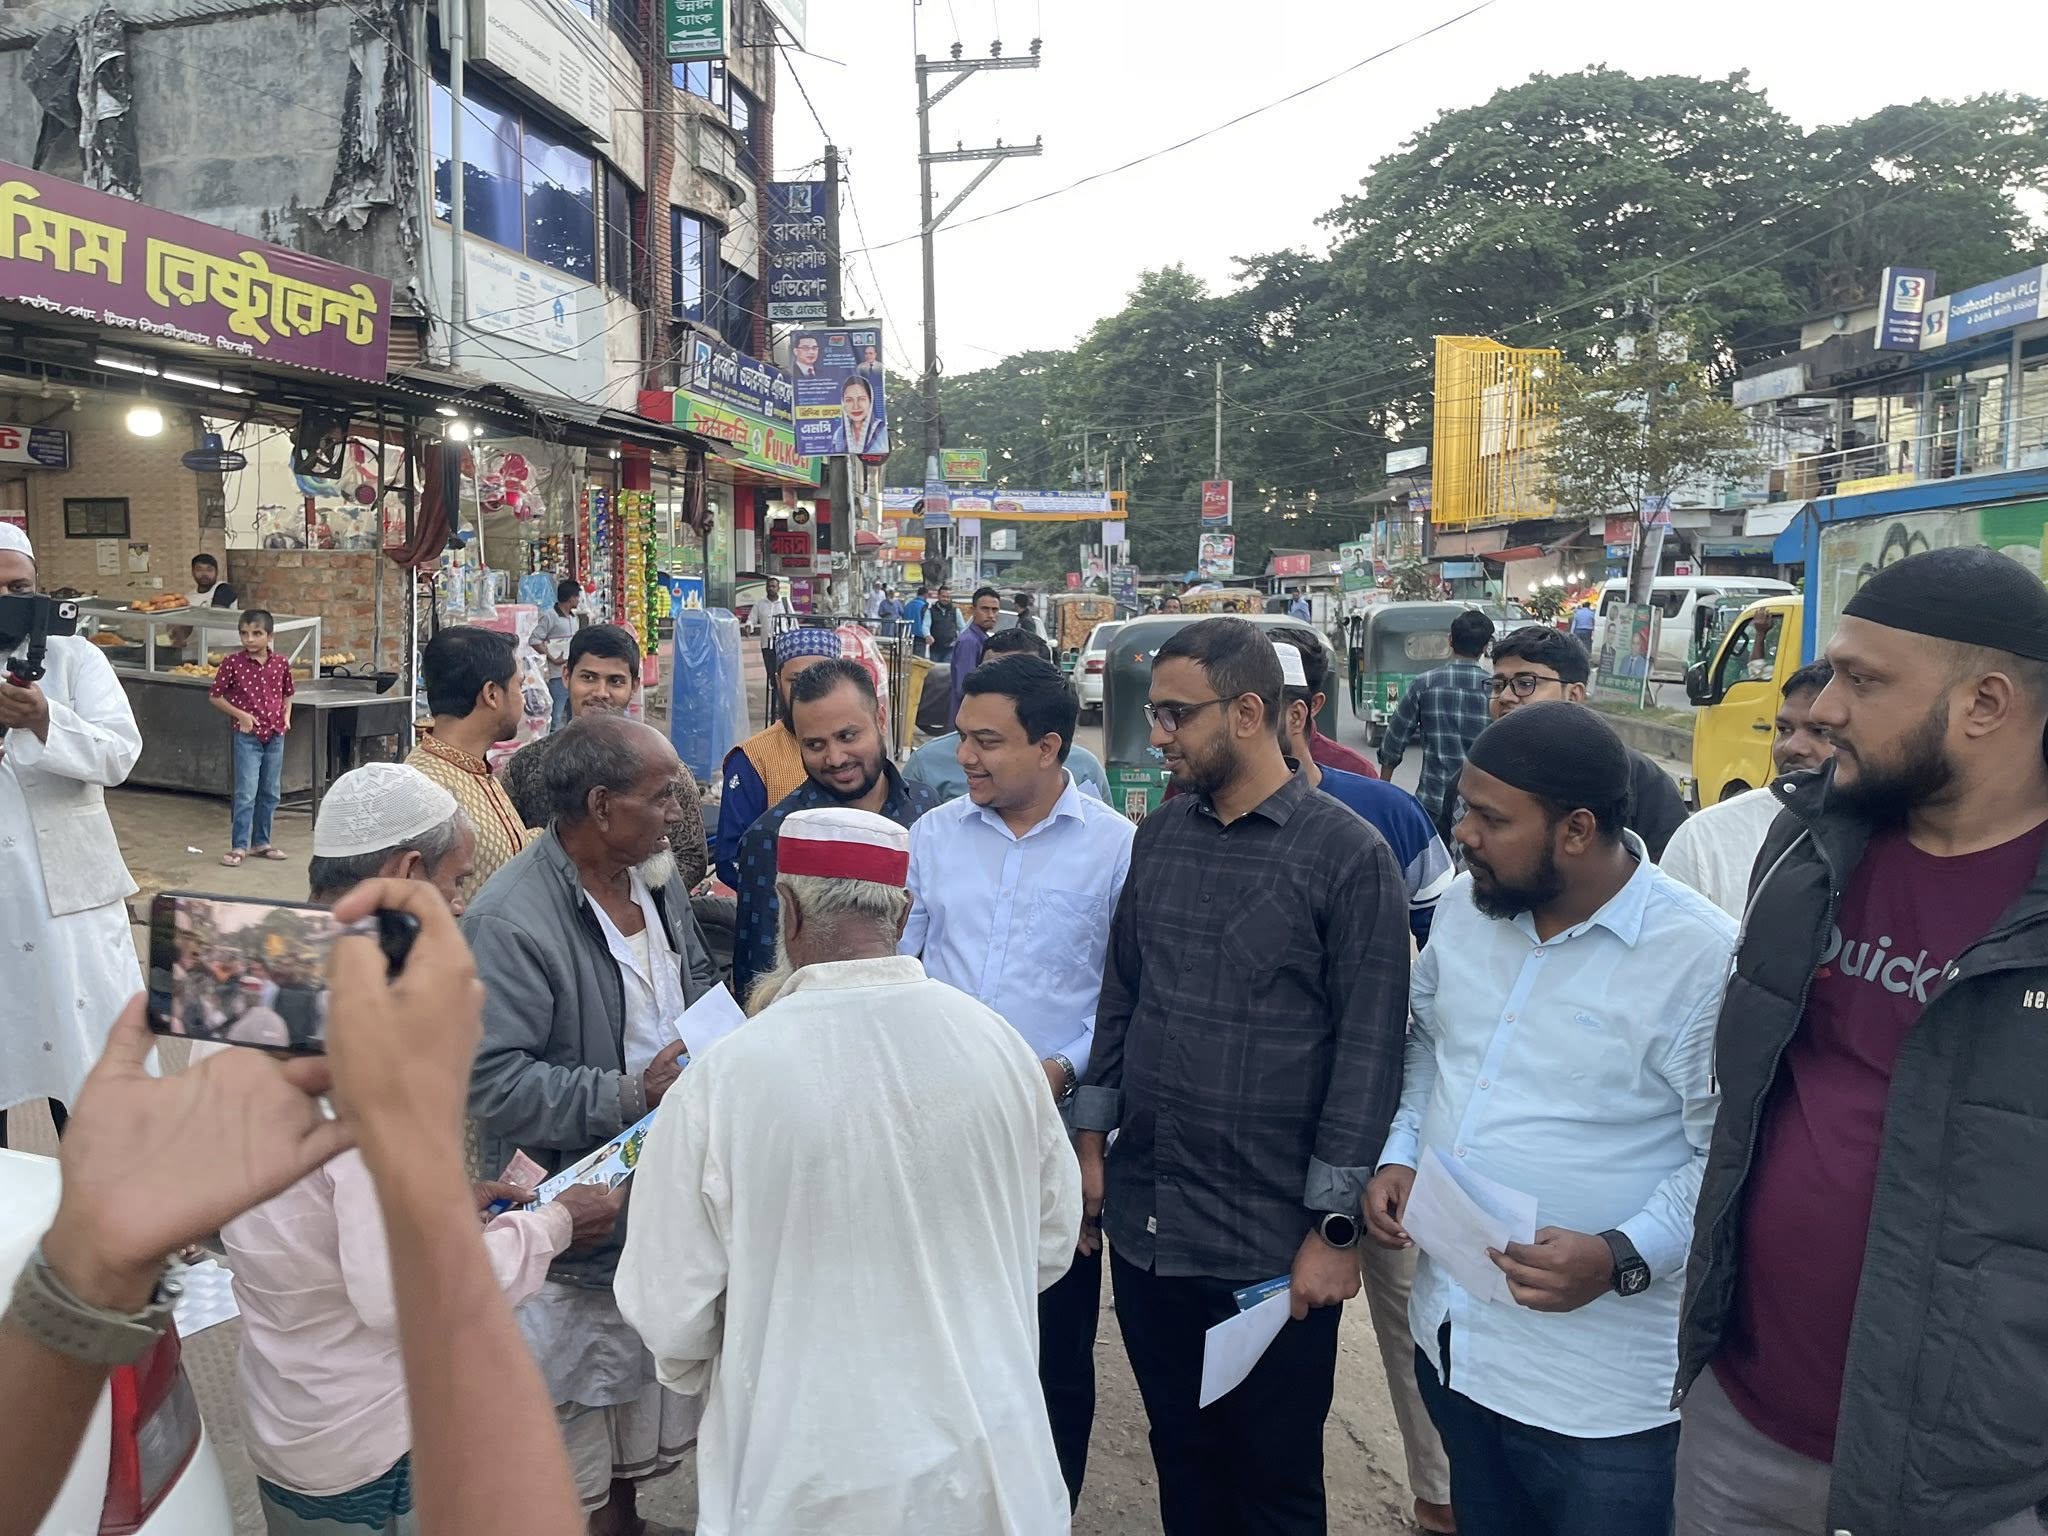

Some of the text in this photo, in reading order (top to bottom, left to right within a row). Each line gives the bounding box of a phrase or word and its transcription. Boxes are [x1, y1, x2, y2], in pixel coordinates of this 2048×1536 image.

[676, 13, 713, 26] ব্যাংক
[1951, 280, 2039, 318] Southeast Bank PLC.
[1973, 311, 1993, 323] bank
[800, 420, 832, 434] এমপি
